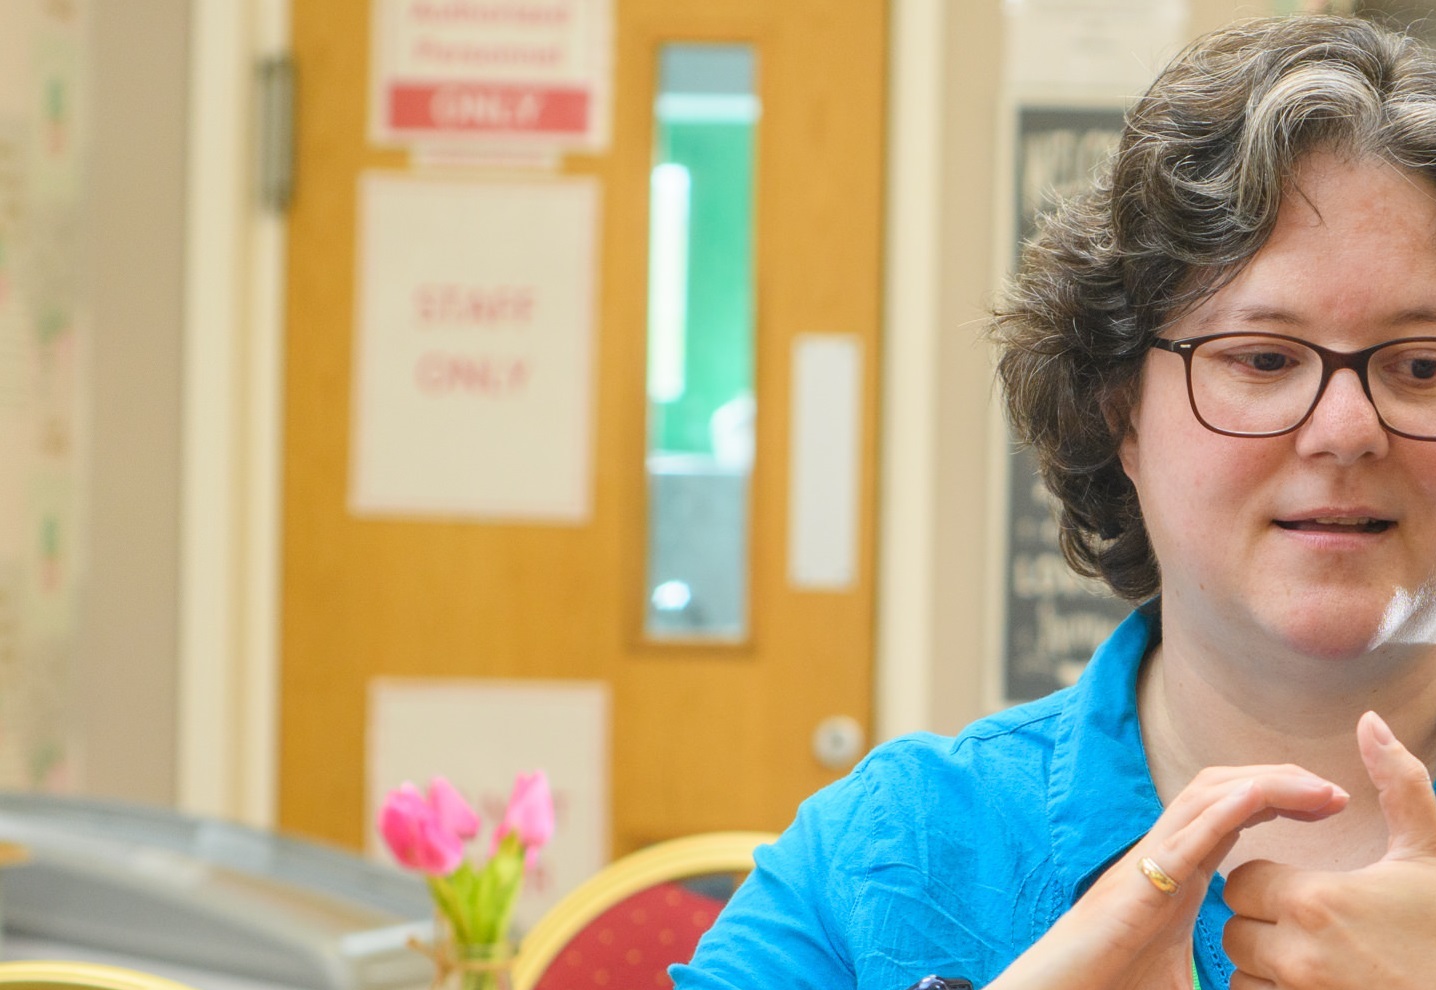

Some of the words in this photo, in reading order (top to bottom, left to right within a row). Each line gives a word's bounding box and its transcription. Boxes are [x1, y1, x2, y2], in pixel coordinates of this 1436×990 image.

[430, 88, 545, 128] ONLY
[412, 284, 535, 328] STAFF
[414, 350, 529, 396] ONLY
